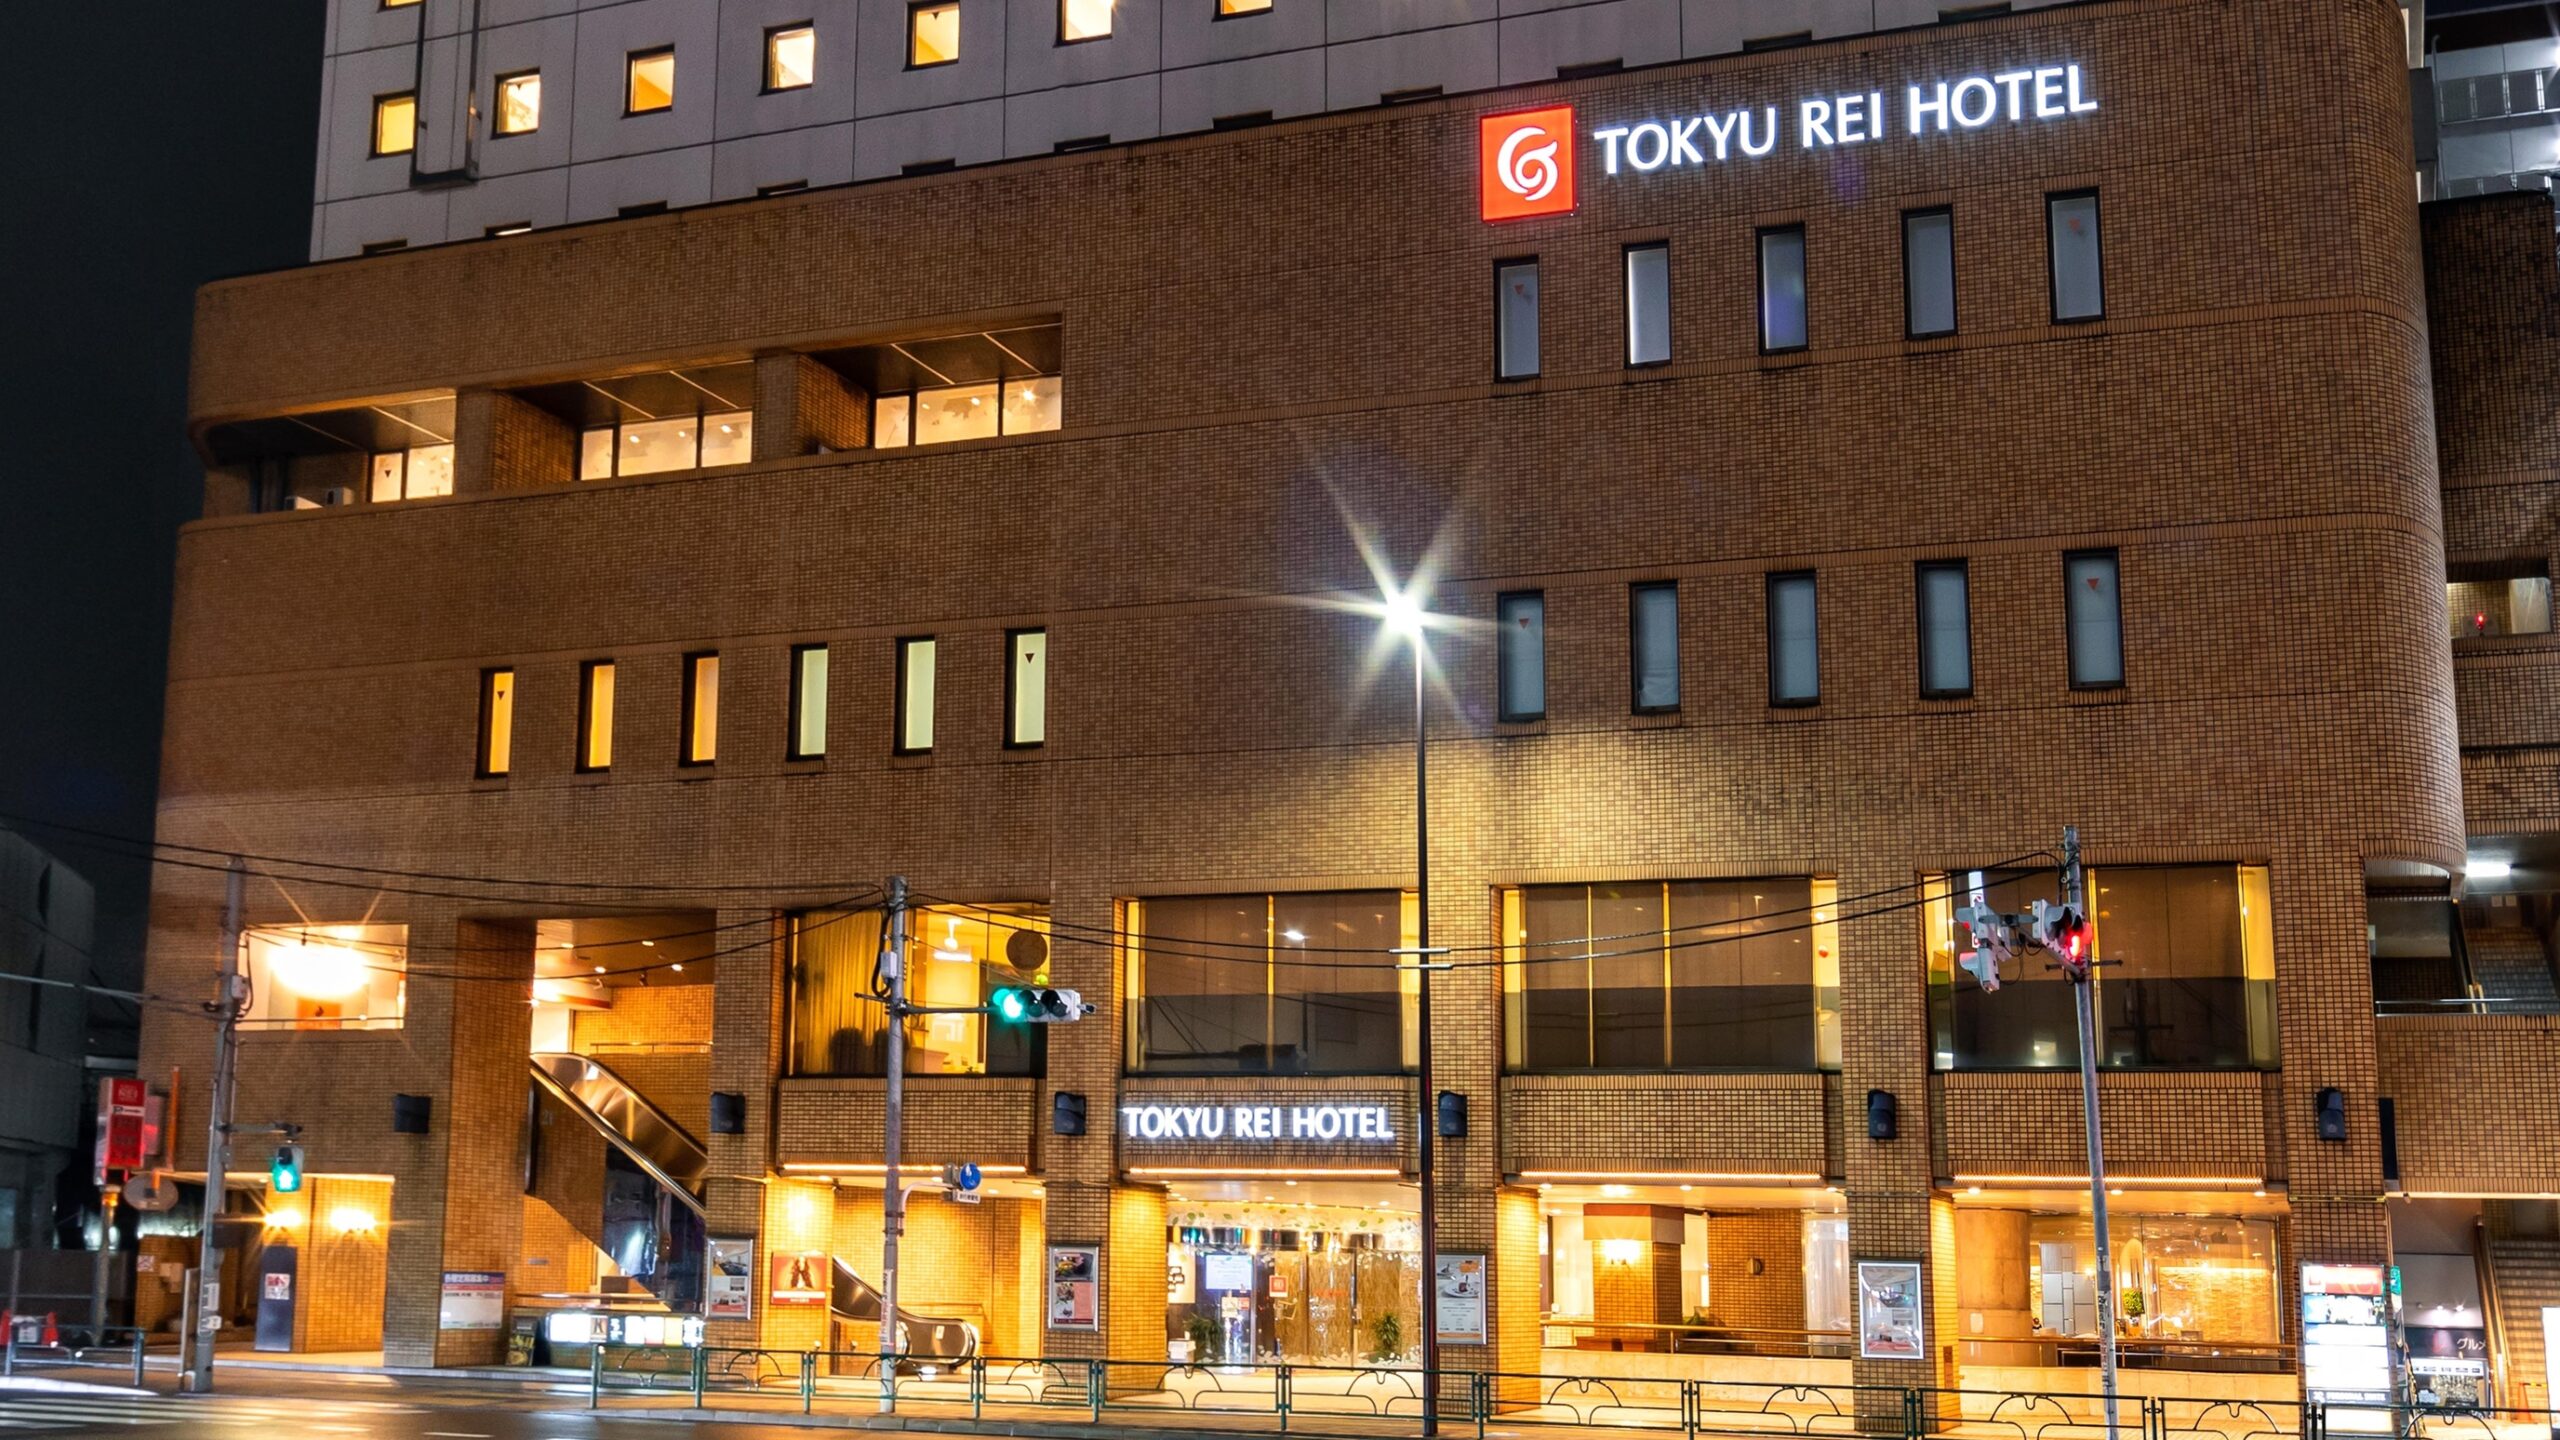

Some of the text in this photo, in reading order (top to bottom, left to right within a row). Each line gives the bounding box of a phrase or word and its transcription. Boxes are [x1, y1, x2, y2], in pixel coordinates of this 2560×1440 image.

[1593, 64, 2098, 174] TOKYU REI HOTEL
[1123, 1106, 1395, 1139] TOKYU REI HOTEL
[2457, 1337, 2486, 1350] グルメ
